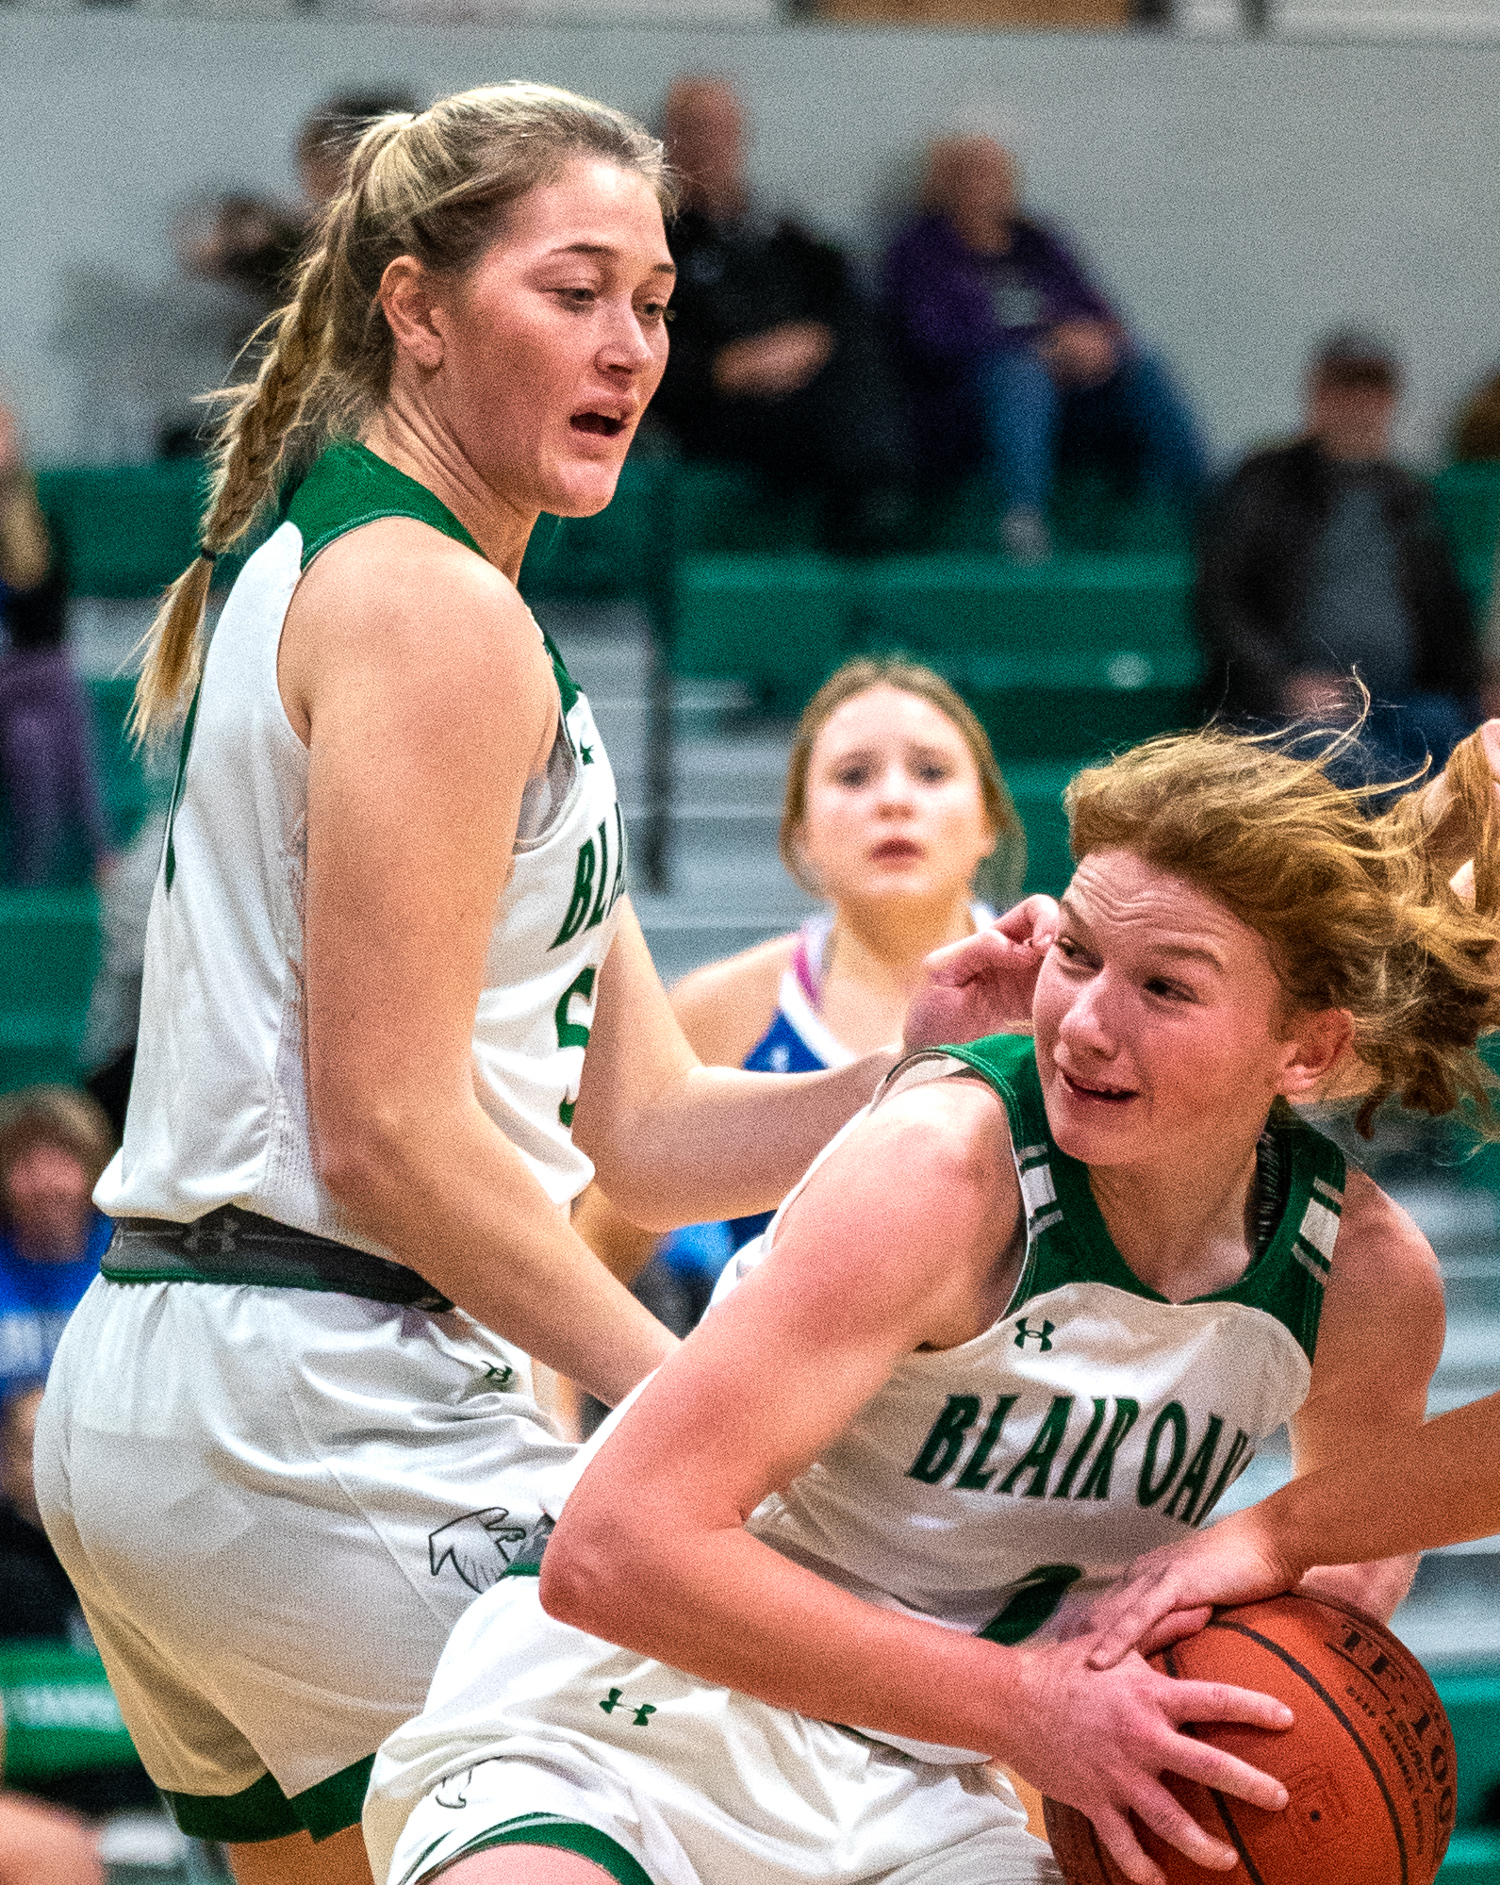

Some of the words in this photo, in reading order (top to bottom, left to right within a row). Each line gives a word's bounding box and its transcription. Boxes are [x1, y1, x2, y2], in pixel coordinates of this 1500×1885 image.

[905, 1394, 1139, 1500] BLAIR
[1137, 1400, 1256, 1527] OAK
[1385, 1707, 1434, 1793] LEGACY
